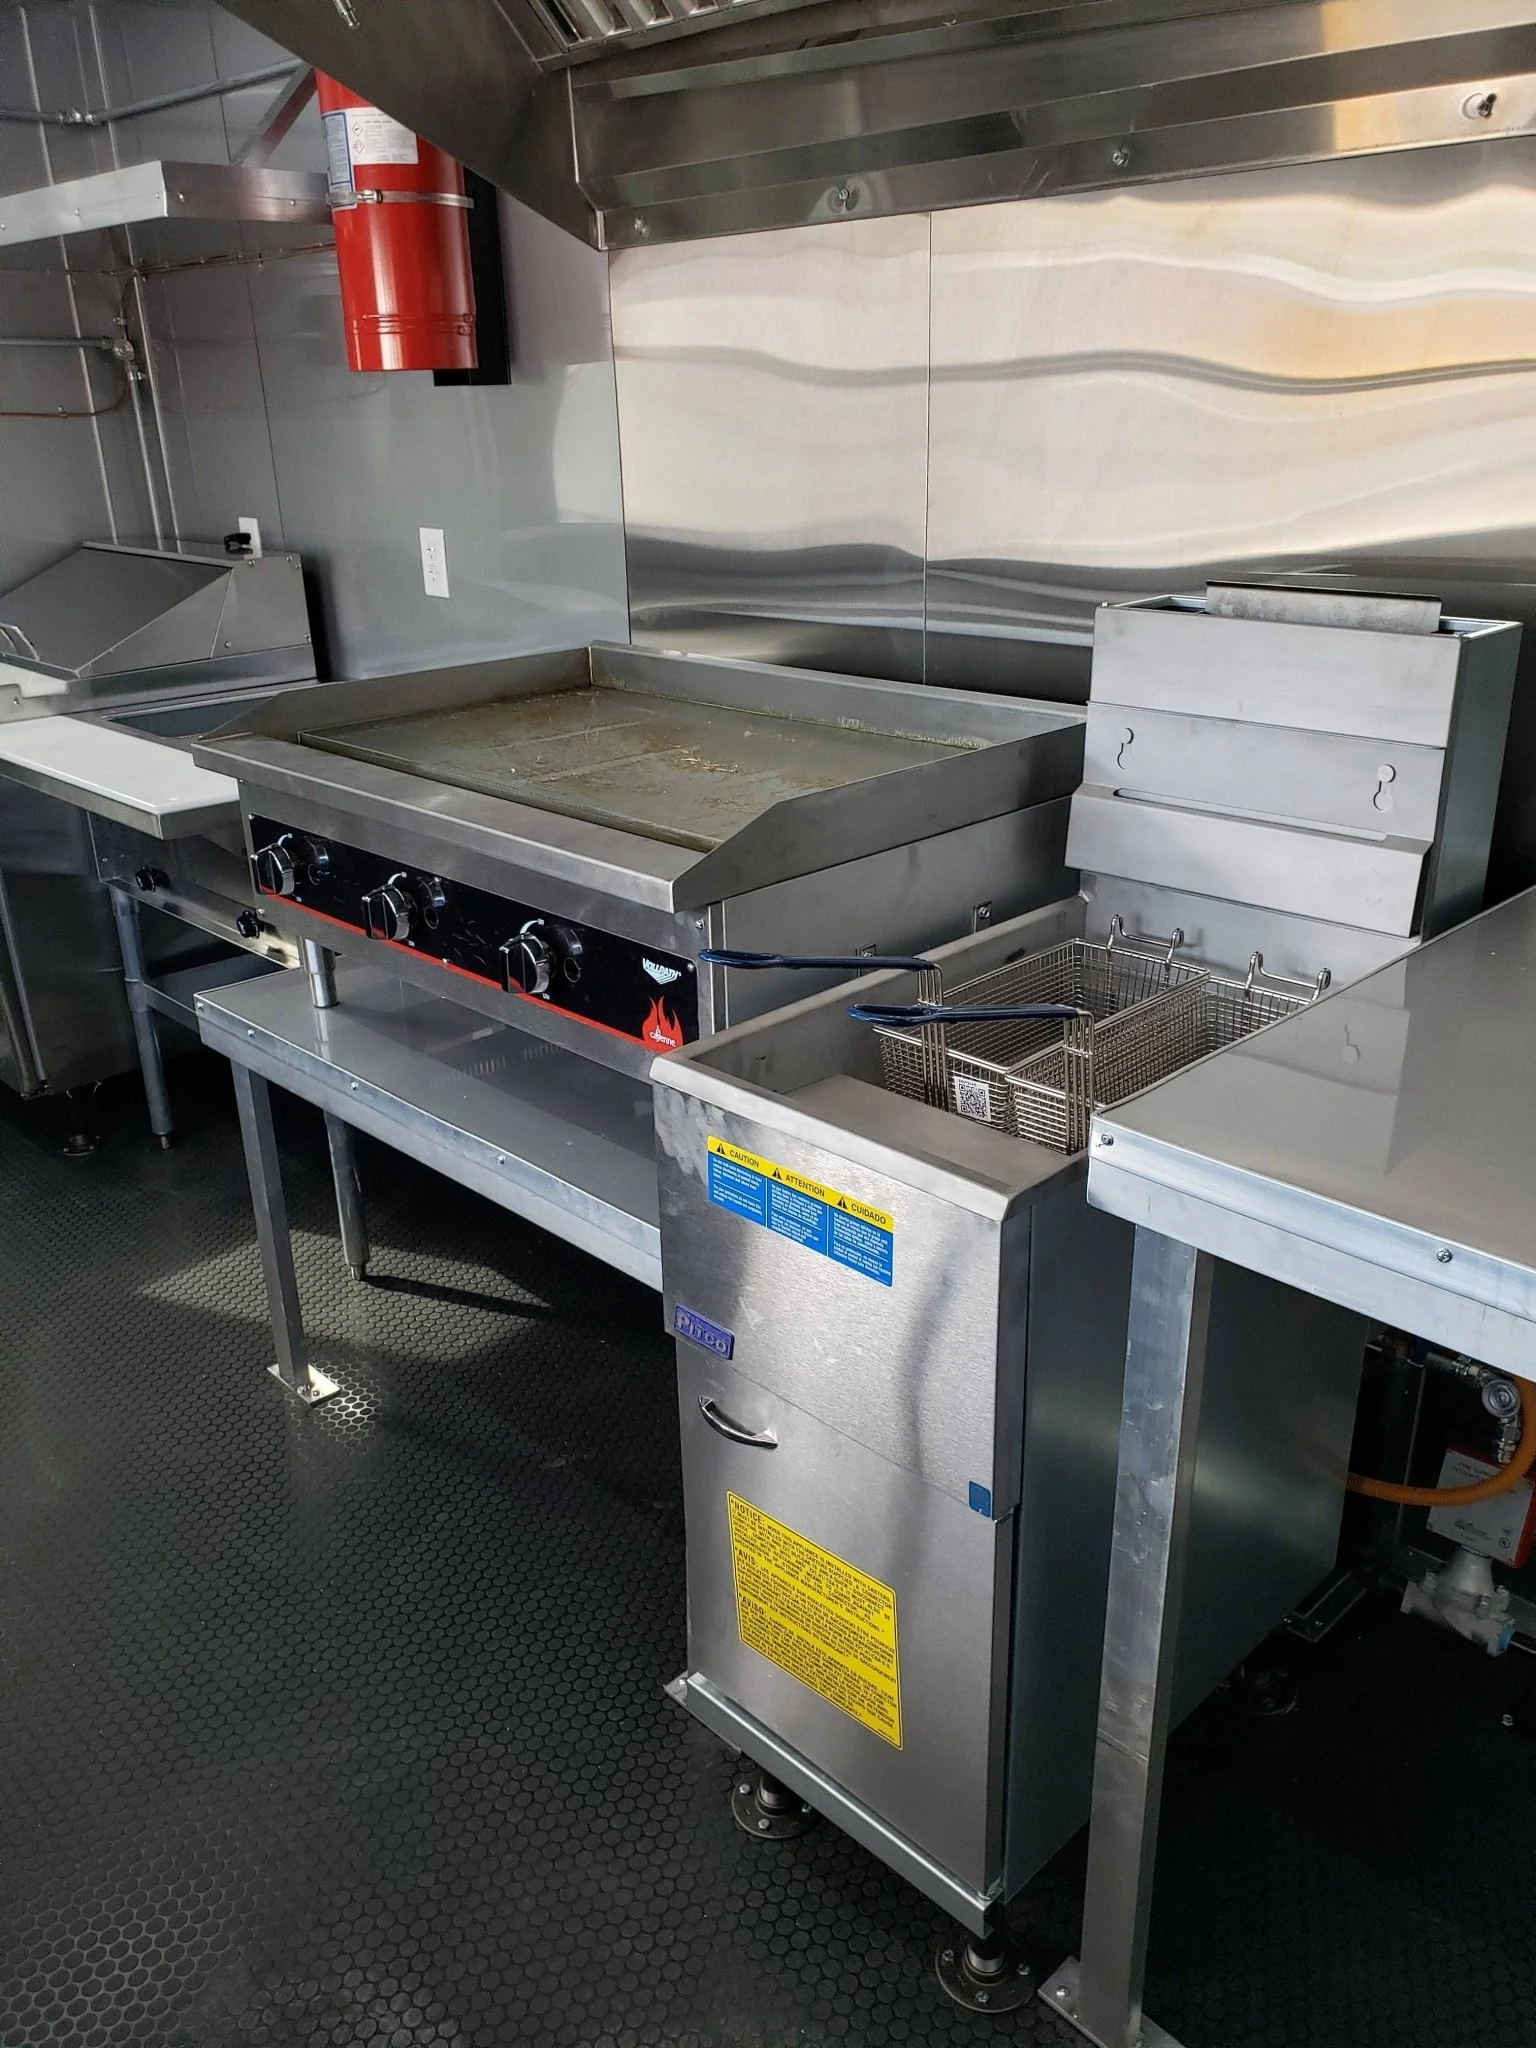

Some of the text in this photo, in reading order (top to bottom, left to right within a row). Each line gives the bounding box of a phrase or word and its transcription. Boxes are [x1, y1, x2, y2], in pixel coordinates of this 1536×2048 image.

[642, 957, 680, 978] VOLLRATH
[729, 1149, 760, 1169] CAUTION
[785, 1174, 825, 1197] ATTENTION
[851, 1203, 886, 1225] CUIDADO
